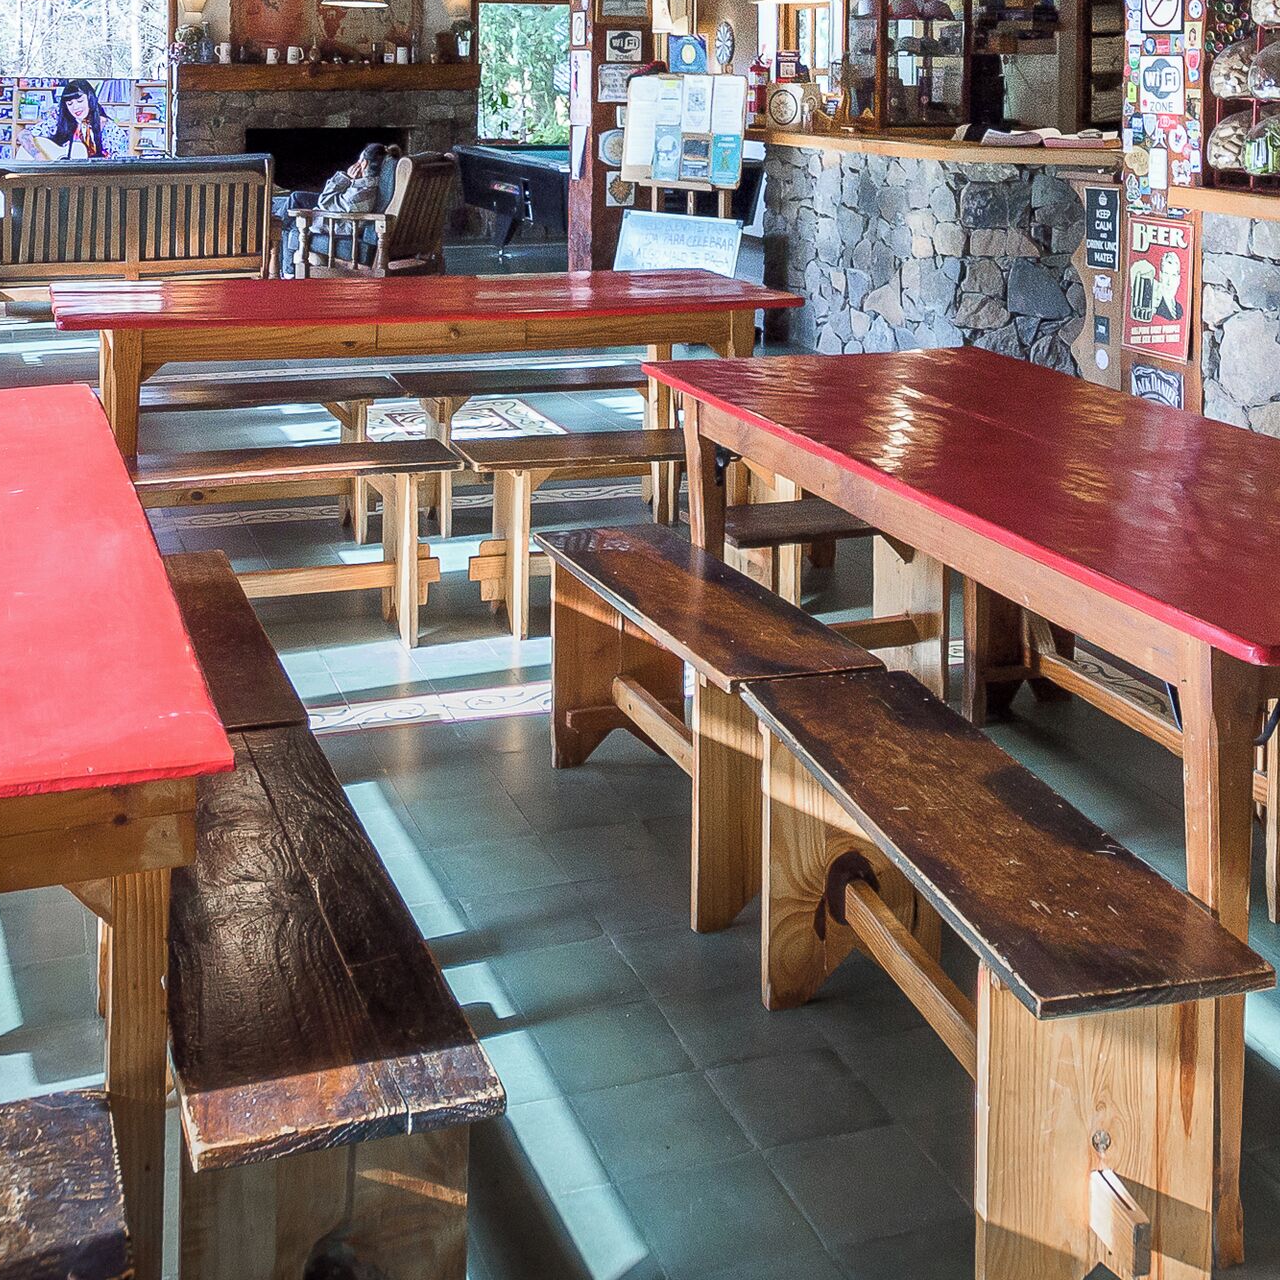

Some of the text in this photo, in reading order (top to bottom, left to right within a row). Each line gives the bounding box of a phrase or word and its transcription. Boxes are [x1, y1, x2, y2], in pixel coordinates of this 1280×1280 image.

[1150, 101, 1174, 112] ZONE
[1095, 209, 1111, 219] KEEP
[1095, 221, 1113, 231] CALM
[1131, 223, 1188, 252] BEER
[686, 235, 736, 252] CELEBRAR
[1087, 239, 1104, 249] DRINK
[1094, 252, 1114, 263] MATES
